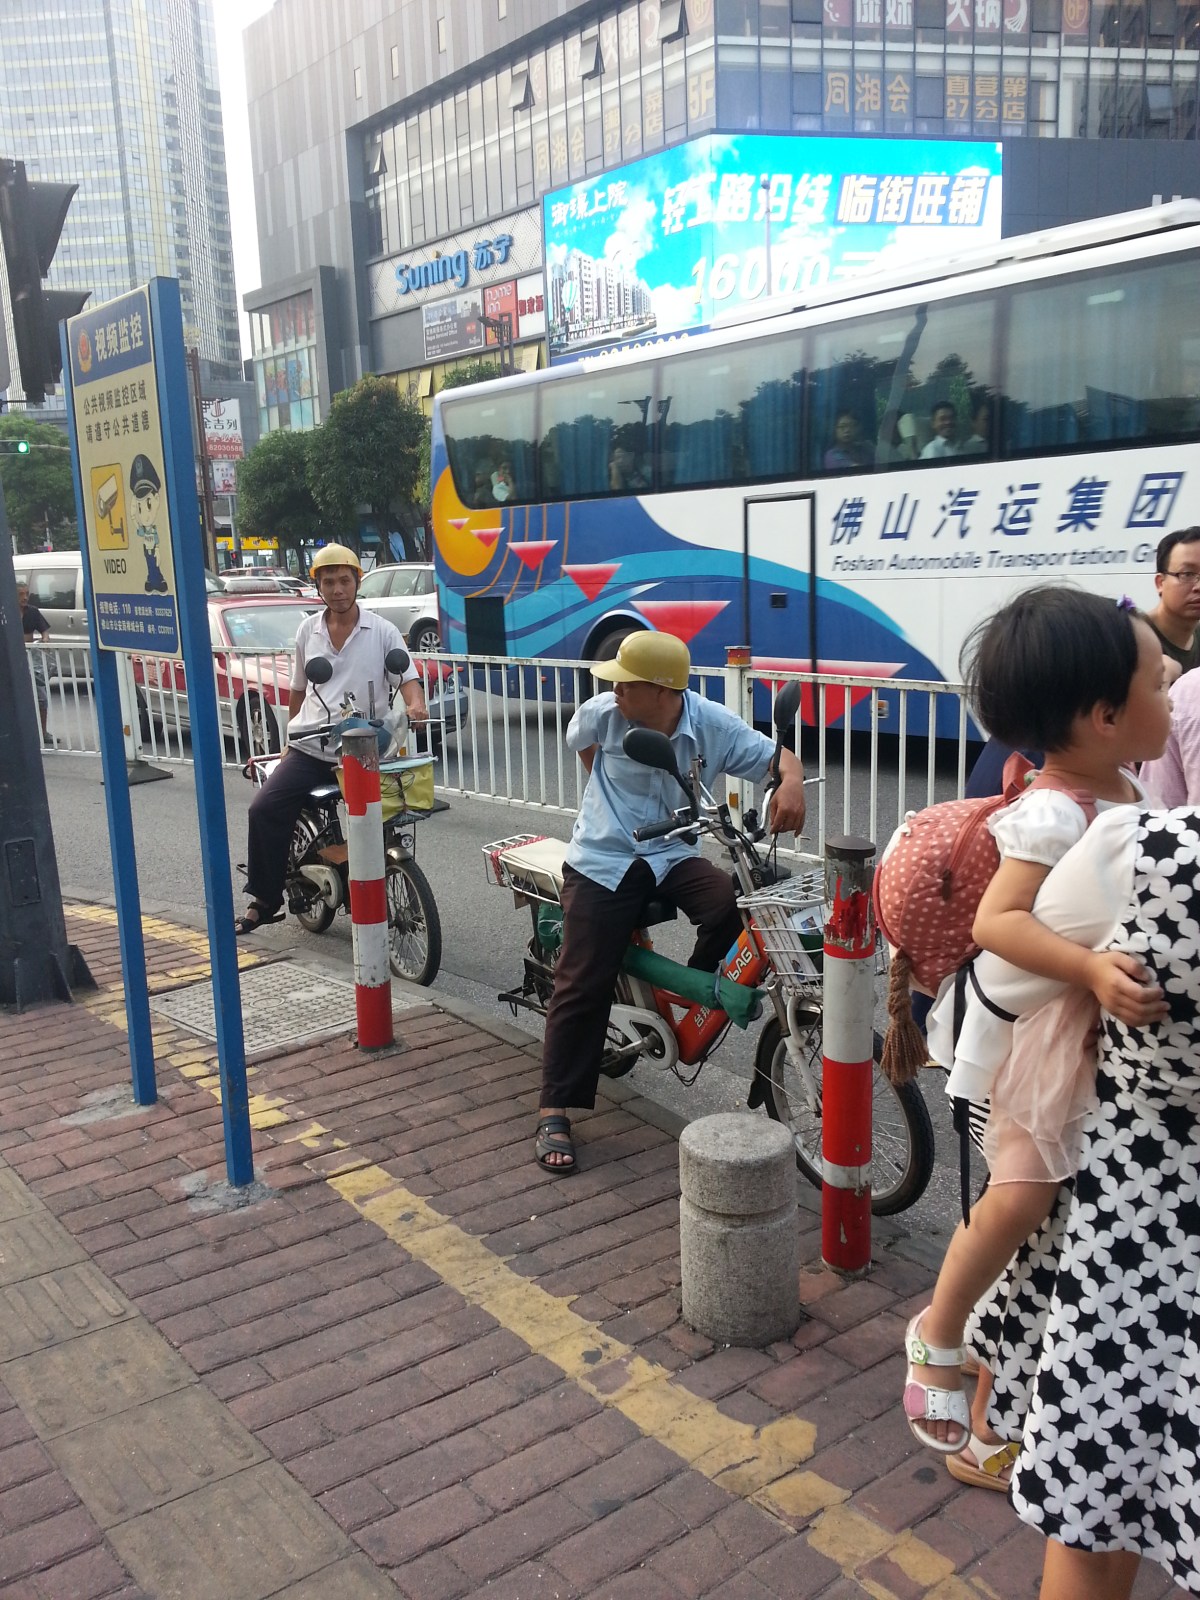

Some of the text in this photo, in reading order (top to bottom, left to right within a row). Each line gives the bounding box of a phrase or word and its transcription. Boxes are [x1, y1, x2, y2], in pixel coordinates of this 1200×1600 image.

[689, 71, 715, 120] 5F
[824, 72, 1027, 114] 同湘会 直营第
[947, 99, 1026, 120] 27分店
[535, 127, 585, 176] 同湘会
[661, 174, 832, 236] 轻工路沿线
[837, 175, 988, 225] 临街旺铺
[395, 234, 513, 295] Suning 苏宁
[95, 312, 144, 362] 视频监控
[83, 380, 147, 416] 公共视频监控区域
[85, 409, 150, 443] 请遵守公共道德
[205, 431, 242, 443] 学必选
[830, 471, 1186, 545] 佛山汽运集团
[104, 558, 127, 574] VIDEO
[831, 555, 886, 574] Foshan
[888, 552, 982, 572] Automobile
[986, 546, 1129, 571] Transportation
